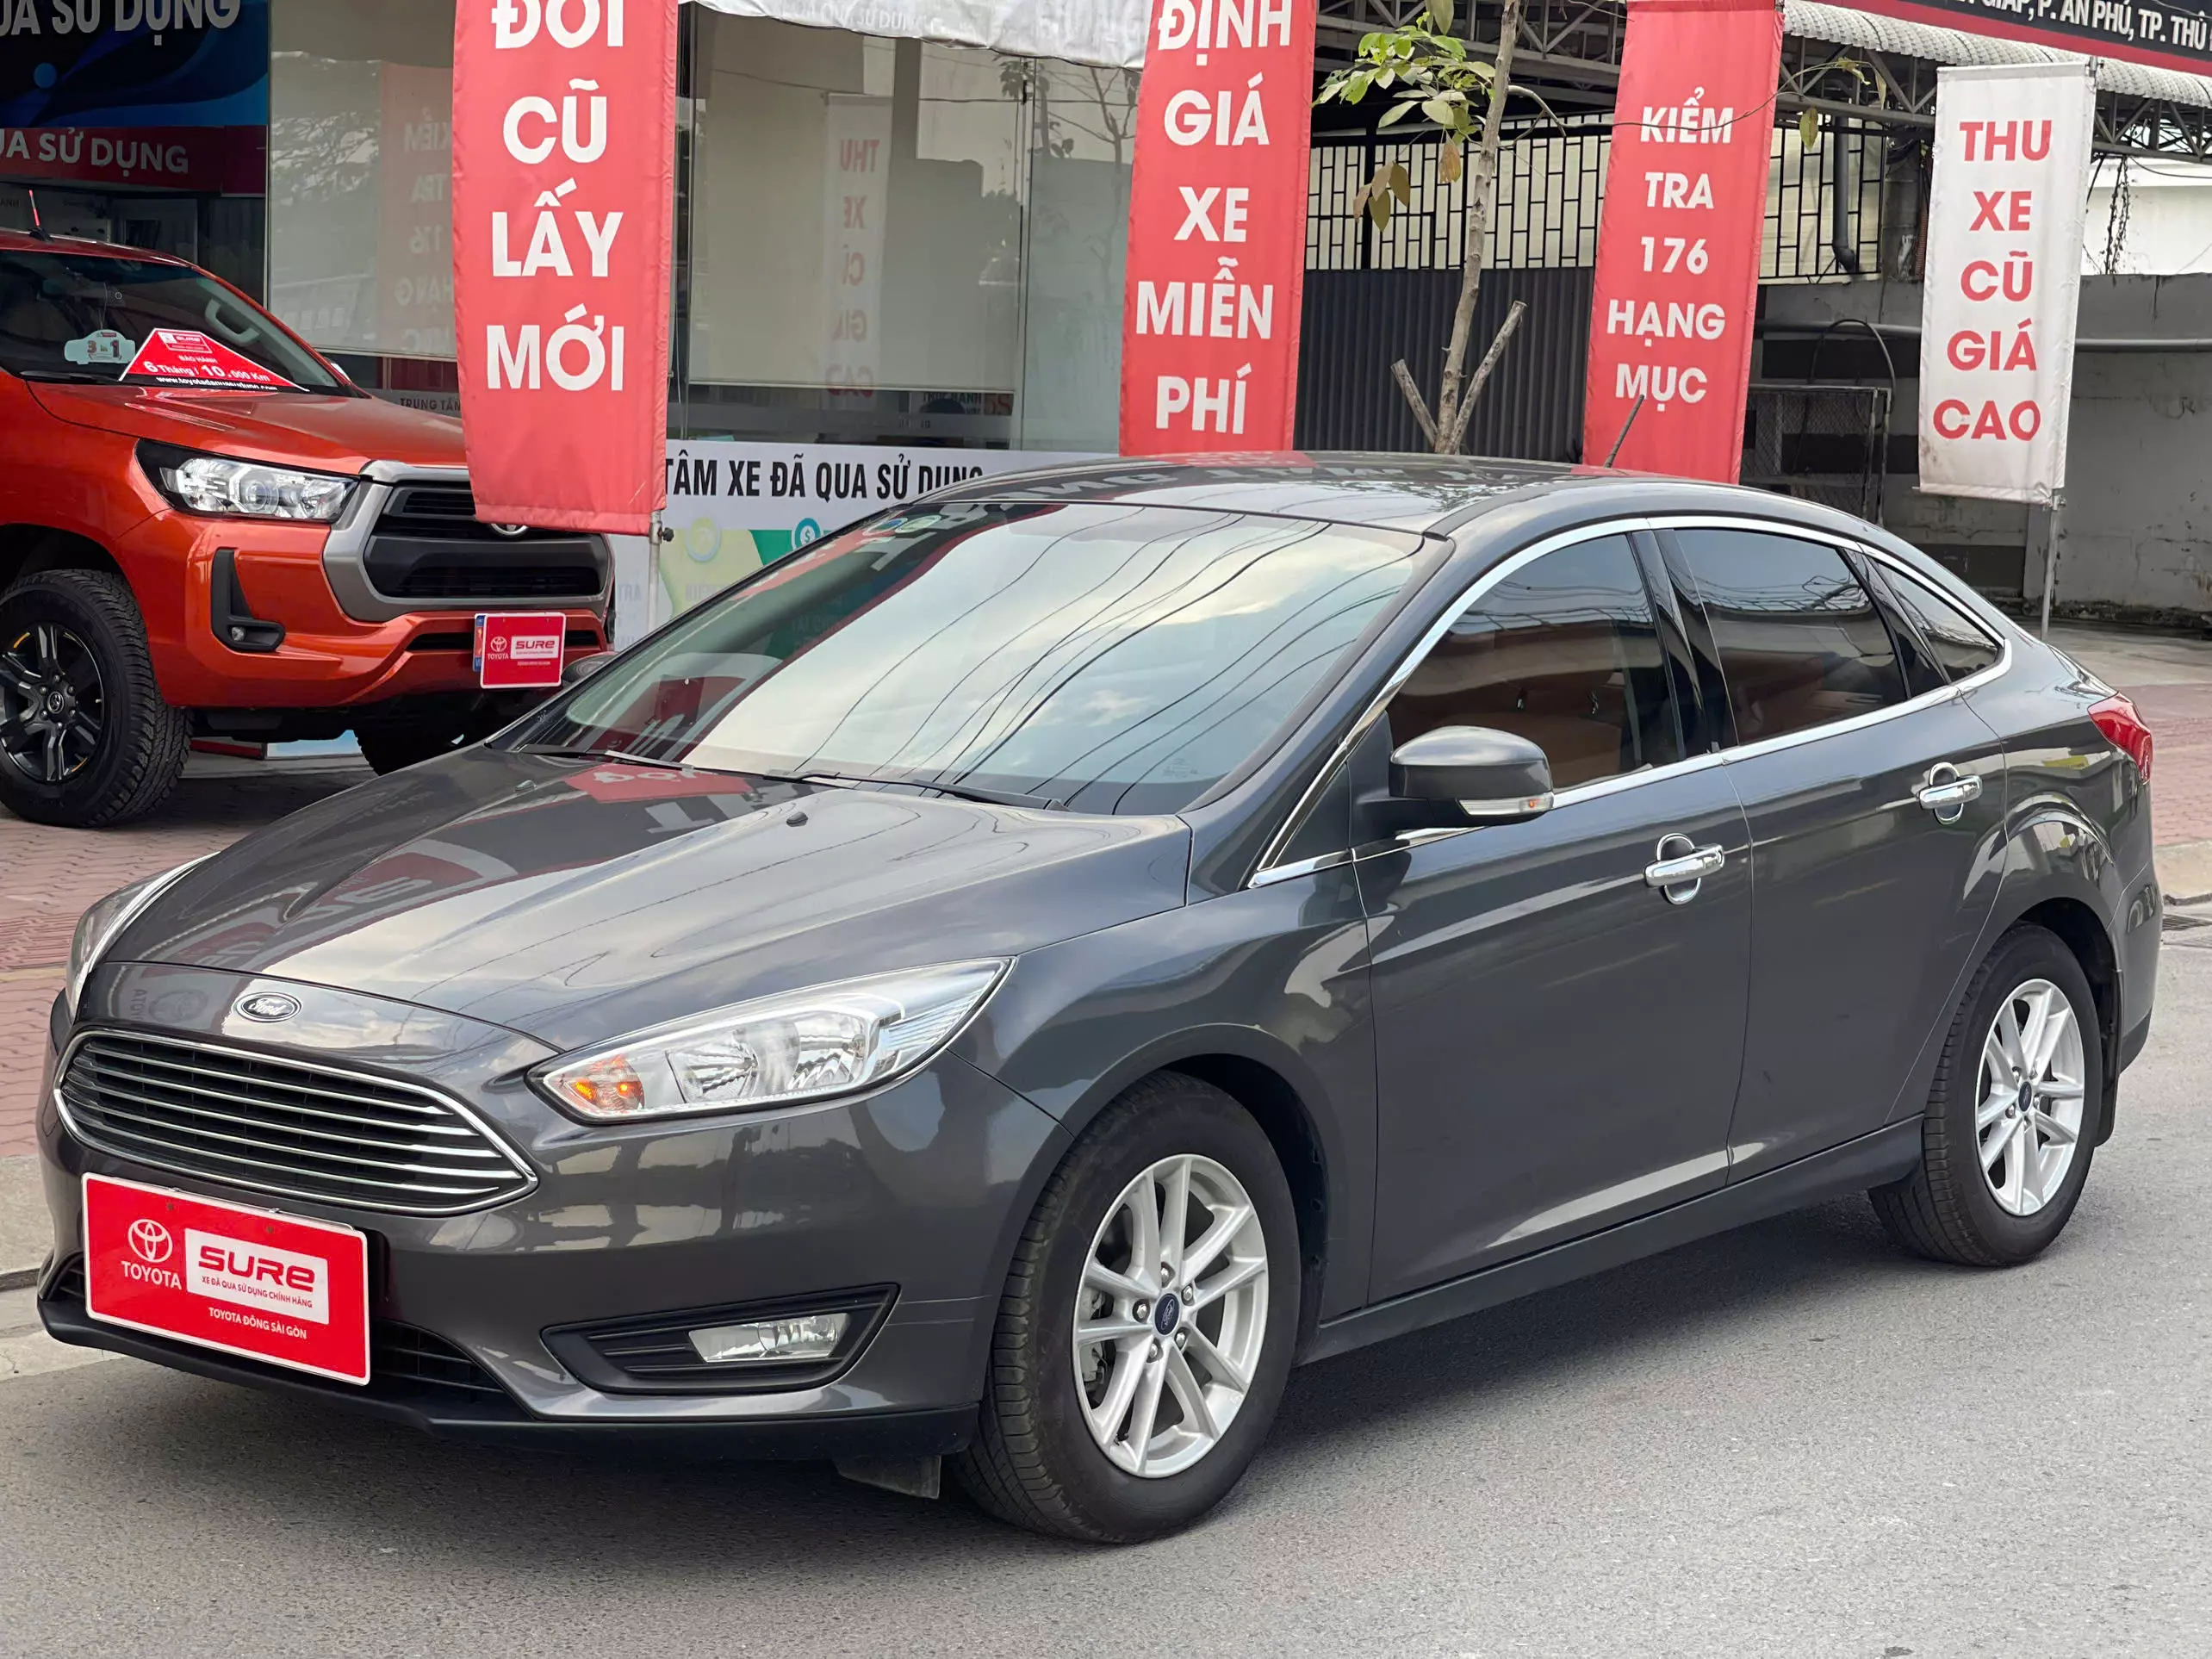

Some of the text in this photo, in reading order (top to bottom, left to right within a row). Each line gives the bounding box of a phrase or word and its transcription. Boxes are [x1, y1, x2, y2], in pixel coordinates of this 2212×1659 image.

[1158, 0, 1292, 65] ĐỊNH
[2138, 9, 2166, 41] TP.
[503, 78, 607, 164] CŨ
[1164, 71, 1270, 146] GIÁ
[1640, 87, 1733, 143] KIỂM
[39, 127, 84, 163] SỬ
[90, 138, 189, 177] DỤNG
[1959, 120, 2052, 161] THU
[1173, 186, 1249, 242] XE
[1645, 172, 1714, 209] TRA
[1969, 190, 2033, 231] XE
[492, 177, 624, 276] LẤY
[1641, 237, 1708, 275] 176
[1960, 251, 2033, 301] CŨ
[1136, 256, 1274, 339] MIỄN
[487, 303, 624, 391] MỚI
[1606, 299, 1725, 347] HẠNG
[1947, 318, 2037, 371] GIÁ
[143, 361, 158, 374] 6
[1615, 363, 1708, 412] MỤC
[1156, 363, 1252, 434] PHÍ
[1933, 399, 2041, 441] CAO
[728, 459, 761, 497] XE
[770, 453, 805, 498] ĐÃ
[816, 462, 867, 503] QUA
[877, 454, 910, 500] SỬ
[121, 1260, 182, 1290] TOYOTA
[221, 1280, 237, 1290] QUA
[247, 1287, 268, 1297] DỤNG
[269, 1291, 291, 1303] CHÍNH
[208, 1307, 308, 1339] TOYOTA ĐÔNG SÀI GÒN
